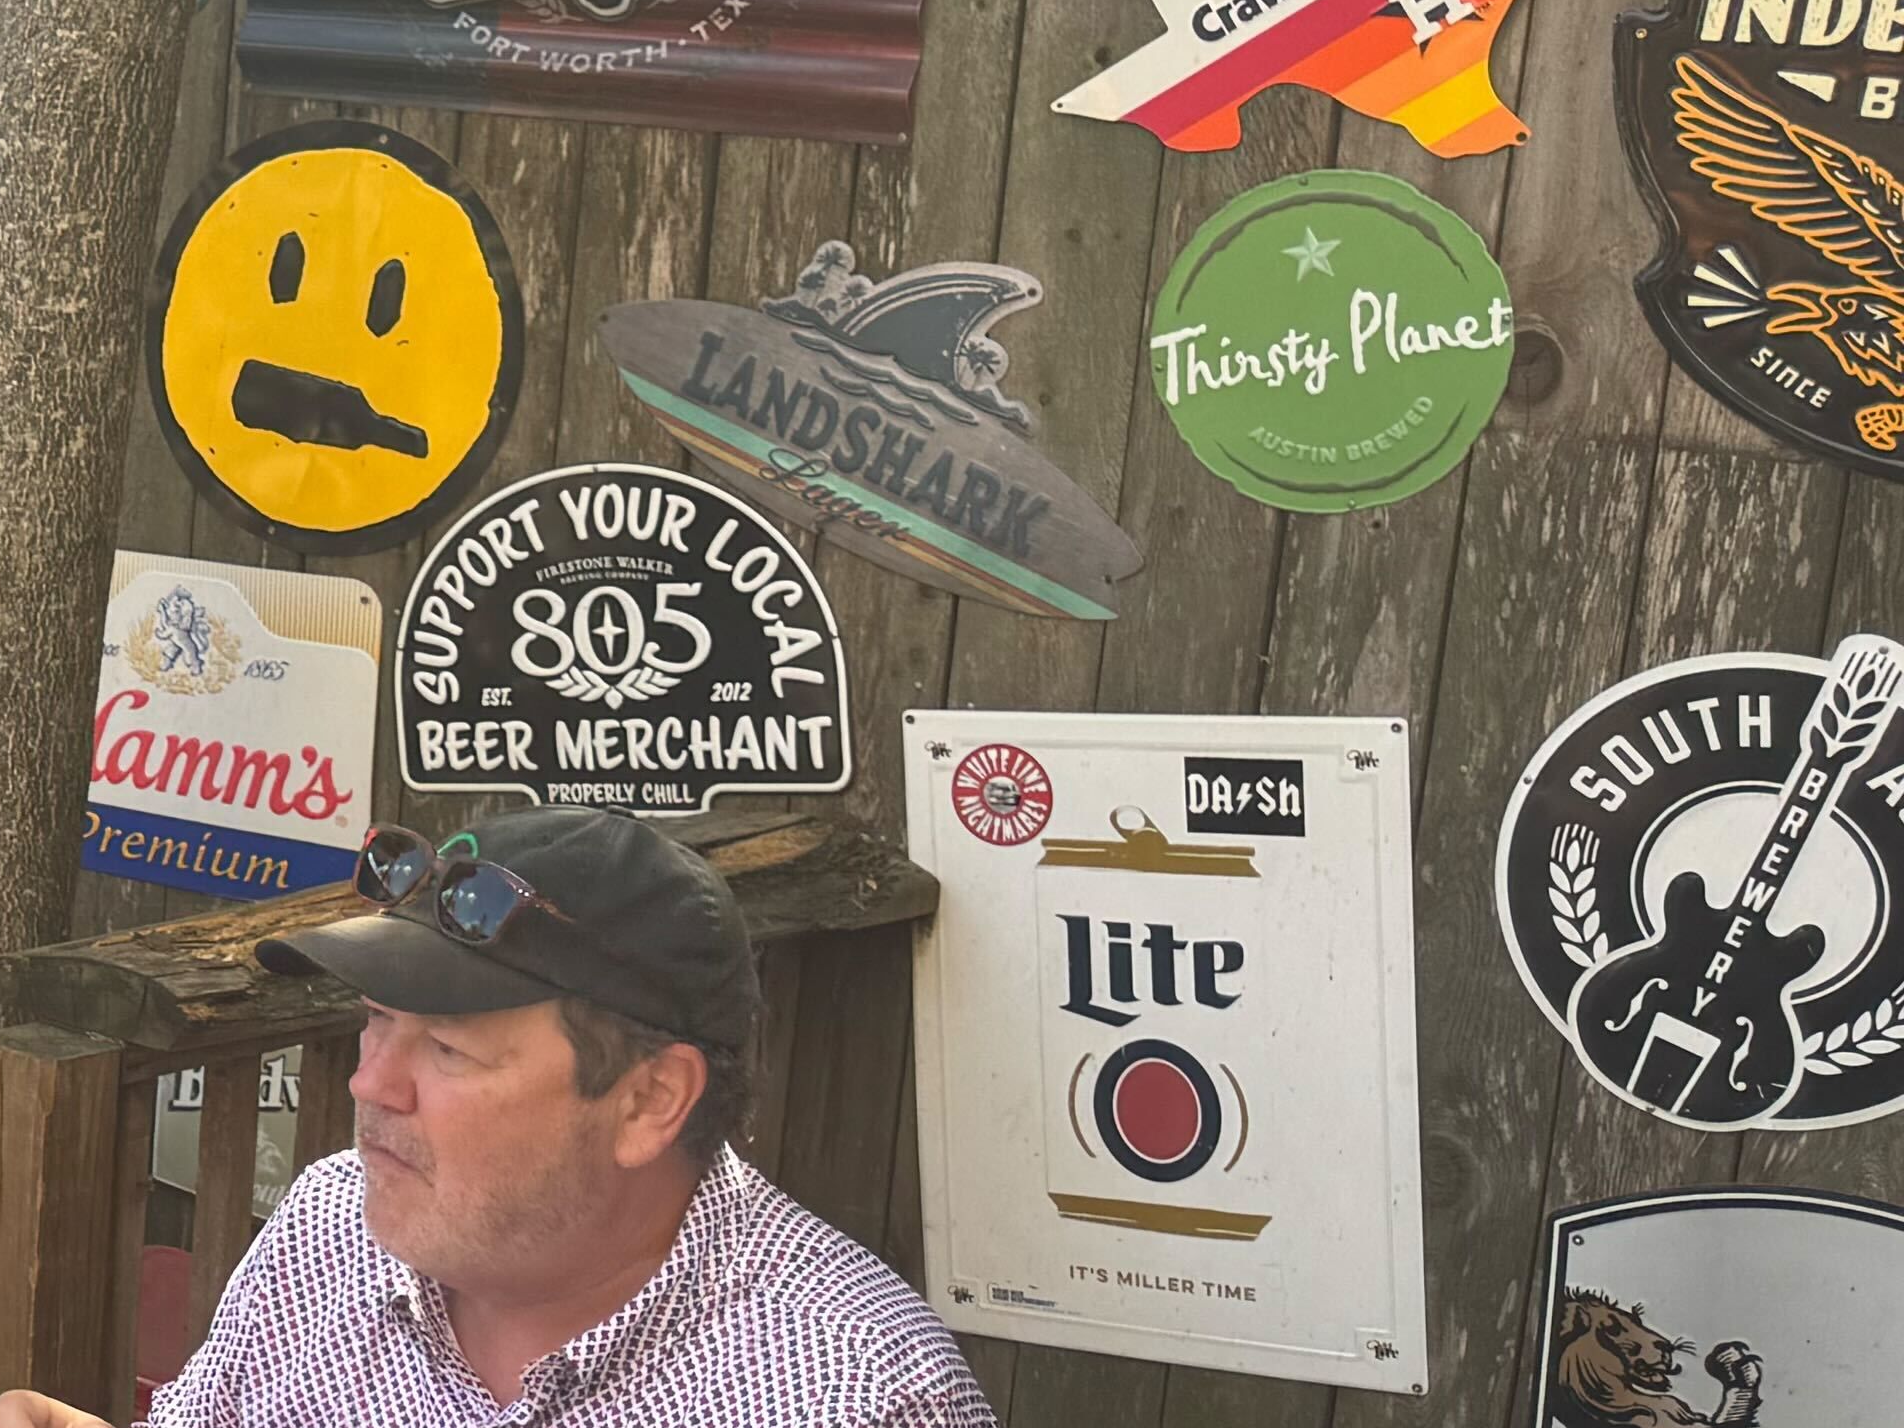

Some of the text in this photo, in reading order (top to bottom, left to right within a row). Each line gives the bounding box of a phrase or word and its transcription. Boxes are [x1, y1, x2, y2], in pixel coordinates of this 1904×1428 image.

[452, 10, 532, 68] FORT
[537, 40, 670, 76] WORTH
[1150, 287, 1514, 406] Thirsty Planet
[1749, 346, 1833, 411] SINCE
[679, 328, 1052, 560] LANDSHARK
[1247, 394, 1434, 465] AUSTIN BREWED
[759, 445, 913, 543] Lager
[412, 483, 827, 704] SUPPORT YOUR LOCAL
[535, 556, 674, 582] FIRESTONE WALKER
[511, 581, 713, 679] 805
[480, 681, 753, 708] EST. 2012
[417, 714, 833, 773] BEER MERCHANT
[956, 747, 1010, 790] WHITE
[1011, 753, 1049, 793] LINE
[1569, 694, 1772, 813] SOUTH
[547, 781, 695, 805] PROPERLY CHILL
[957, 795, 1049, 842] NIGHTMARES
[1692, 767, 1829, 1018] BREWERY
[1055, 912, 1245, 1028] Lite
[1069, 1262, 1258, 1303] IT'S MILLER TIME
